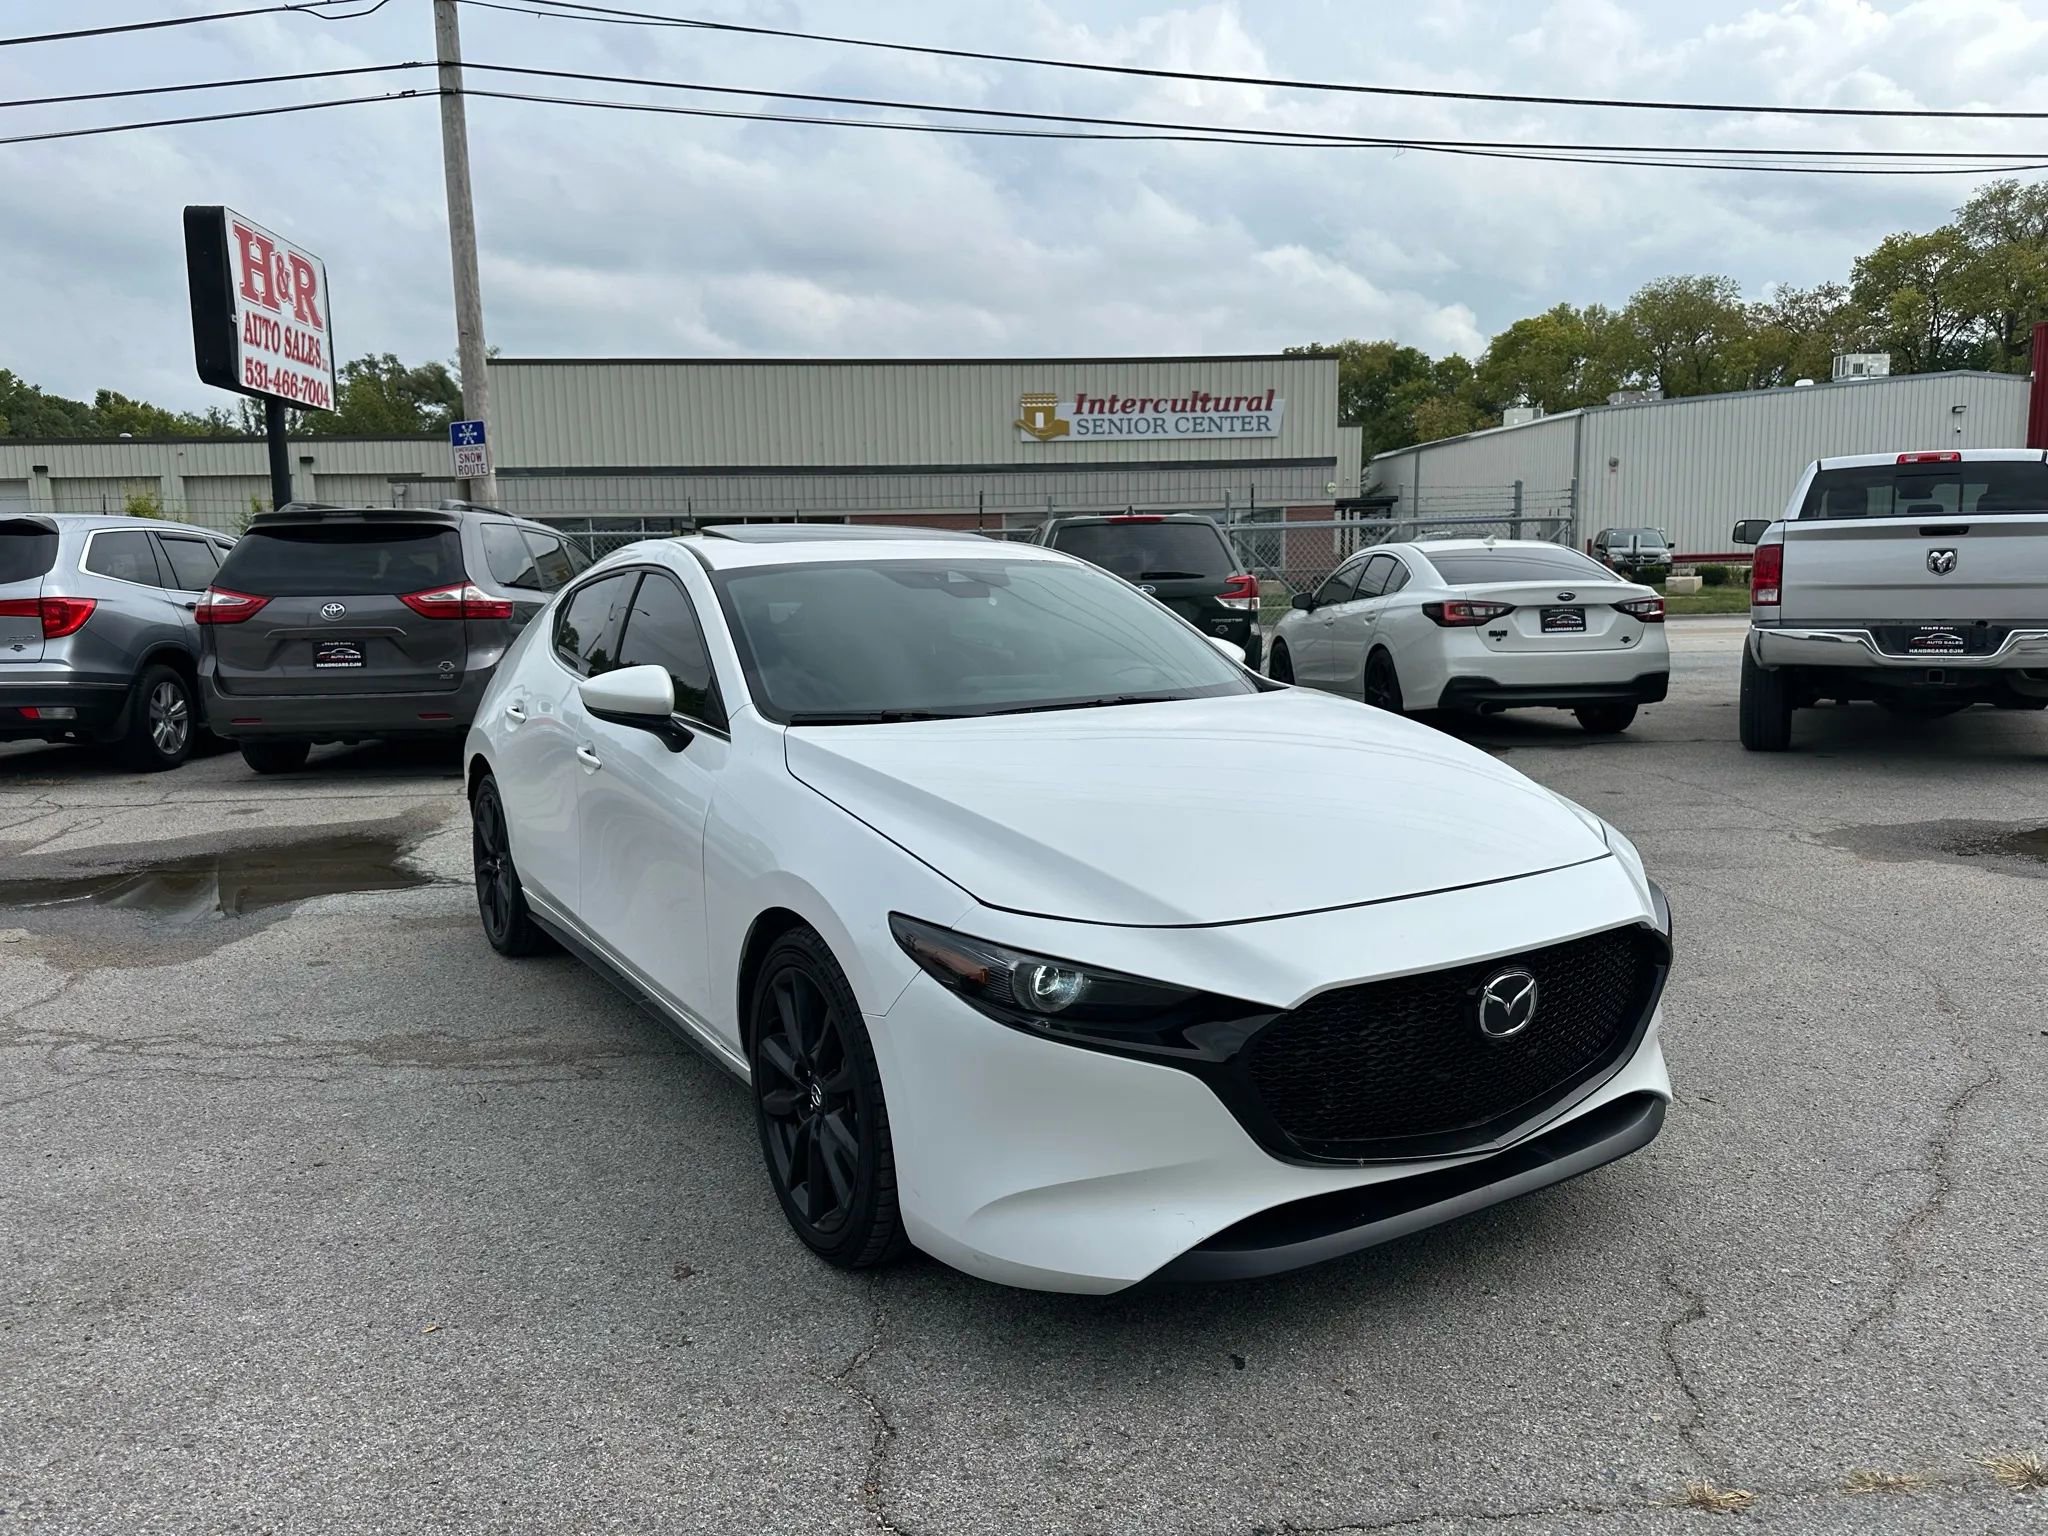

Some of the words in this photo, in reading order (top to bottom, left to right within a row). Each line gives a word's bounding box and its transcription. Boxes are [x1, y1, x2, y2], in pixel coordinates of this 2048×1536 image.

[232, 219, 324, 332] H&R
[243, 309, 281, 356] AUTO
[284, 325, 321, 371] SALES
[244, 355, 331, 408] 531-466-7004
[1072, 388, 1275, 415] Intercultural
[1076, 416, 1169, 436] SENIOR
[1174, 414, 1273, 434] CENTER
[458, 452, 482, 464] SNOW
[458, 463, 486, 476] ROUTE
